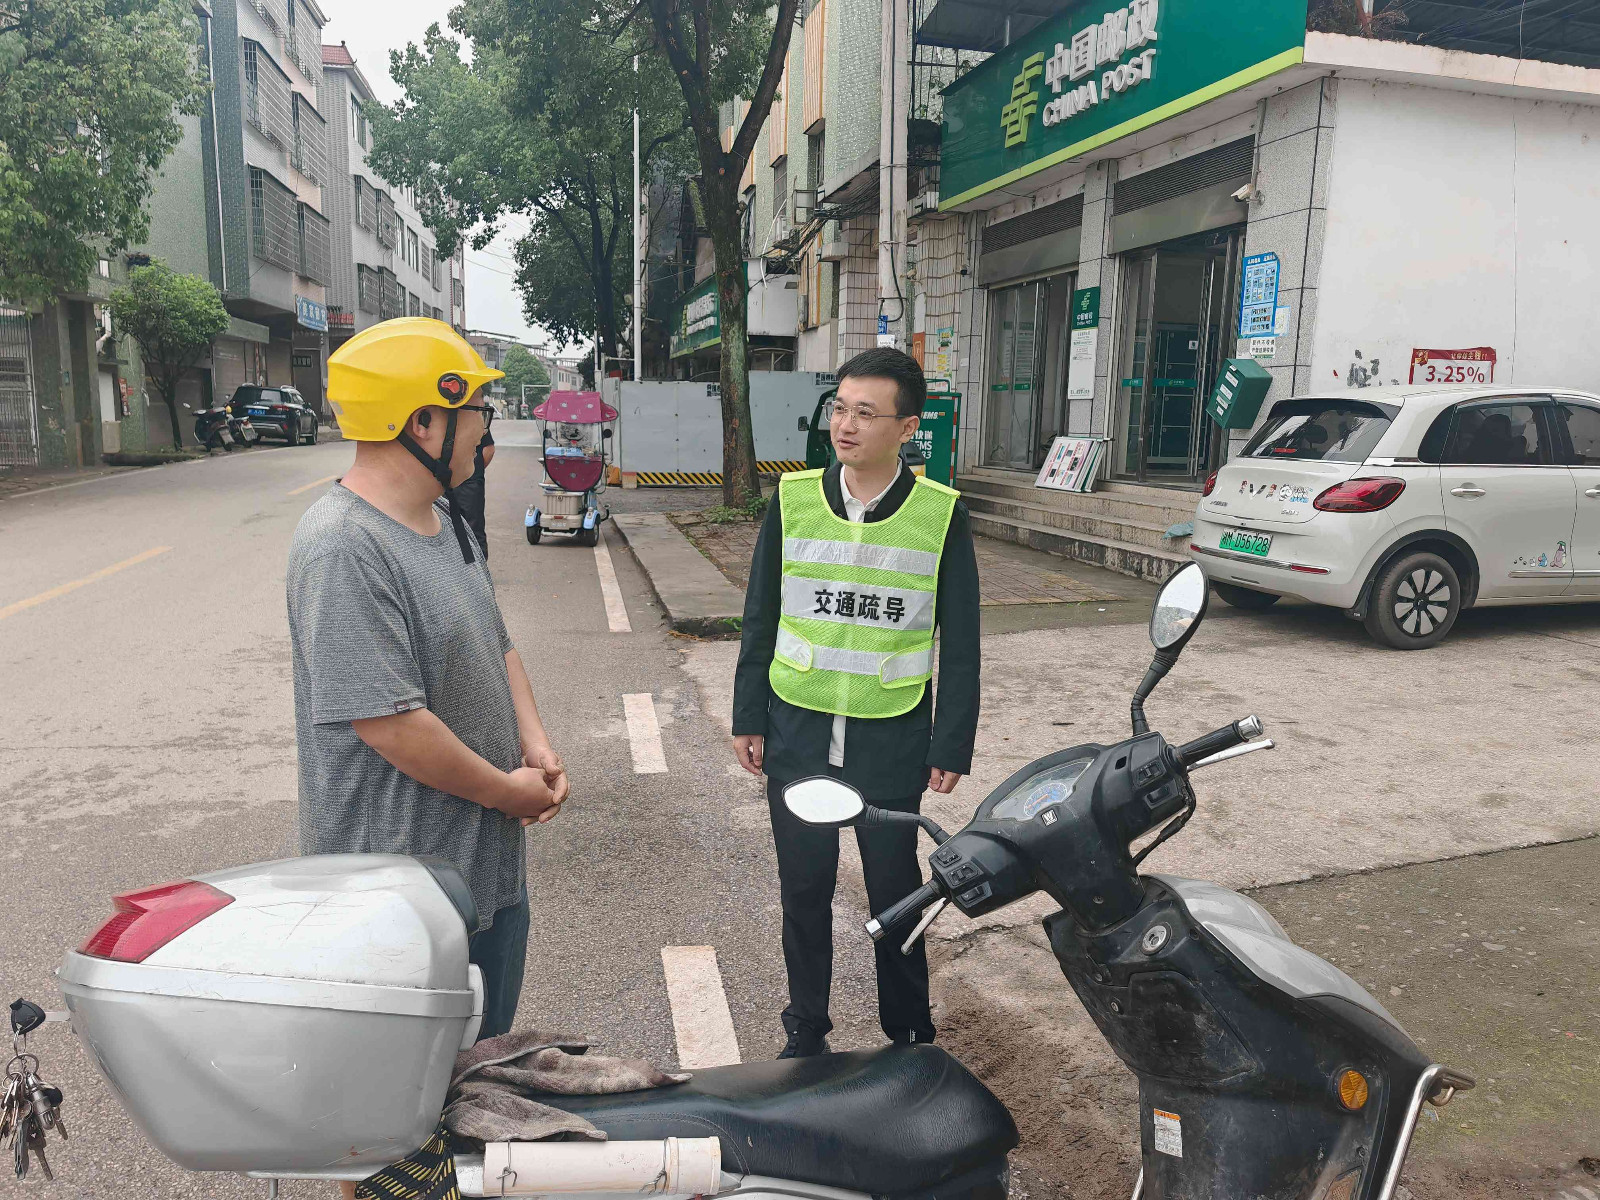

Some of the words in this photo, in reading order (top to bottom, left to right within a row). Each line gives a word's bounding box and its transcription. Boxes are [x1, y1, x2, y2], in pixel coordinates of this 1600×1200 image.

[1045, 0, 1158, 93] 中国邮政
[1042, 81, 1099, 127] CHINA
[1101, 48, 1156, 100] POST
[1425, 365, 1485, 383] 3.25%
[813, 589, 906, 623] 交通疏导
